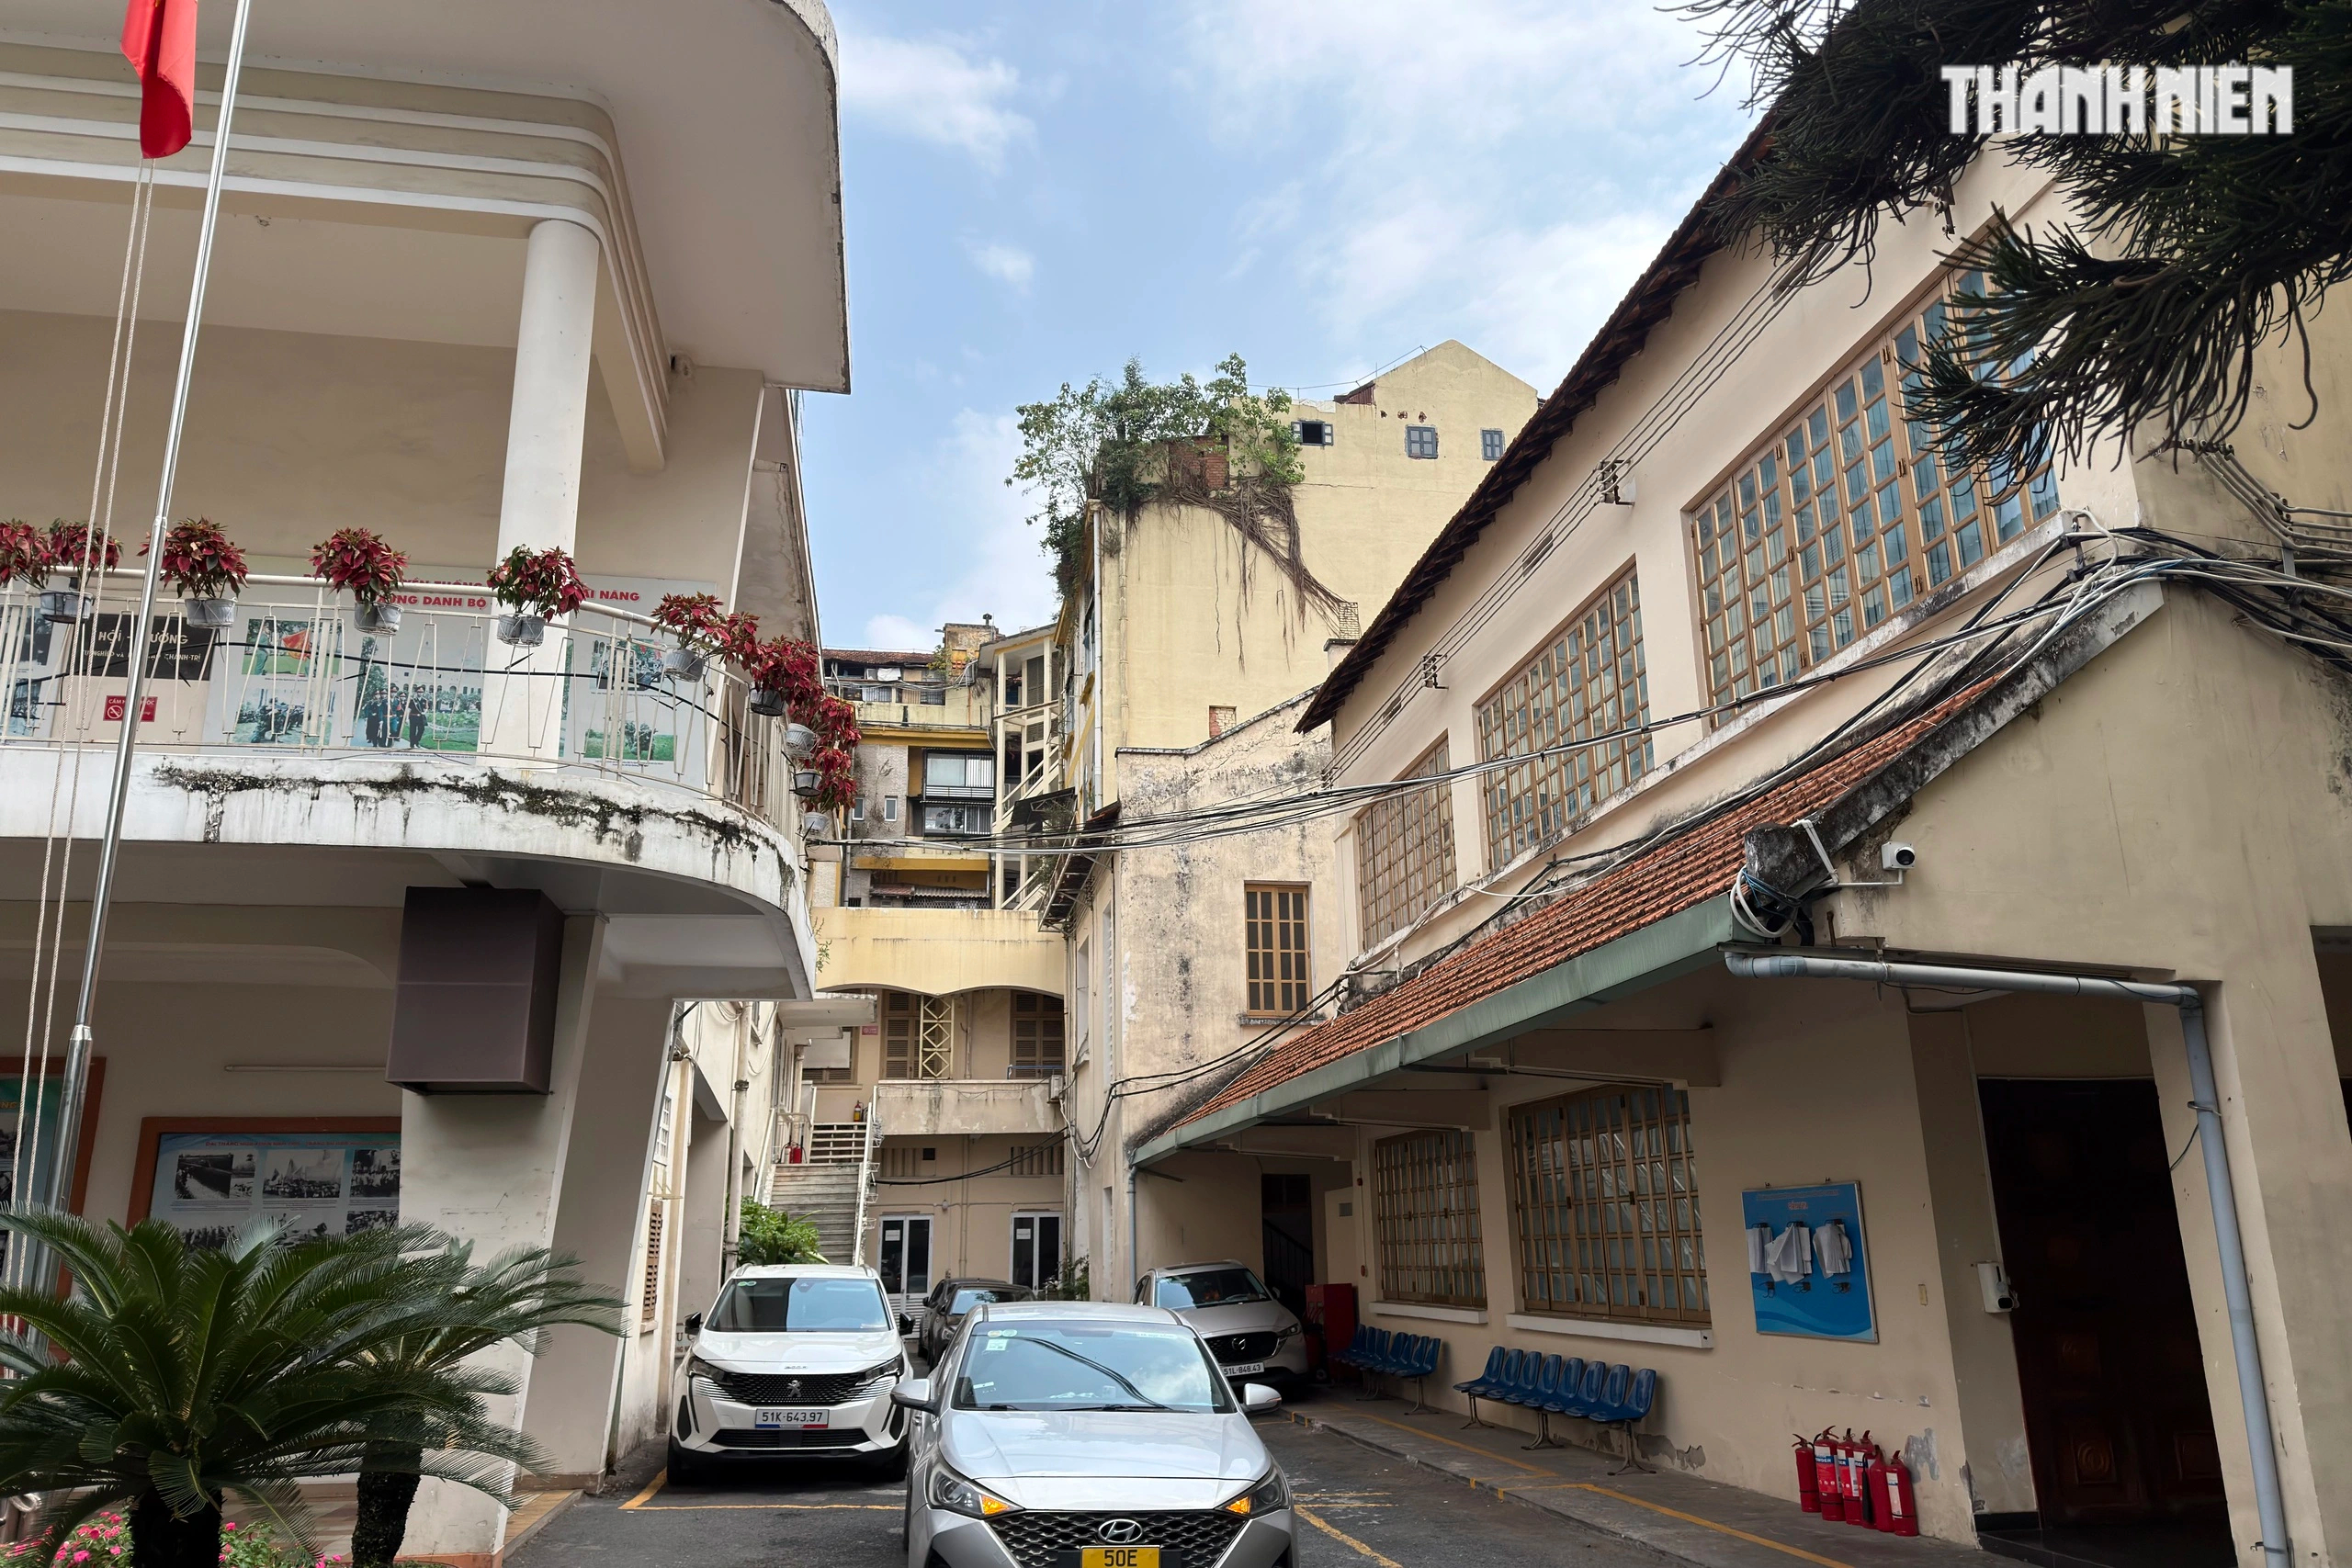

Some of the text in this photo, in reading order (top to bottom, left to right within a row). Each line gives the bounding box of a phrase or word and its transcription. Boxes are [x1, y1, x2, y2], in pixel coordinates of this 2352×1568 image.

[599, 589, 639, 602] NĂNG
[423, 596, 462, 607] DANH
[467, 596, 486, 610] BỘ
[151, 630, 188, 644] ƯỜNG
[762, 1412, 823, 1422] 51K-643.97
[1104, 1550, 1137, 1567] 50E
